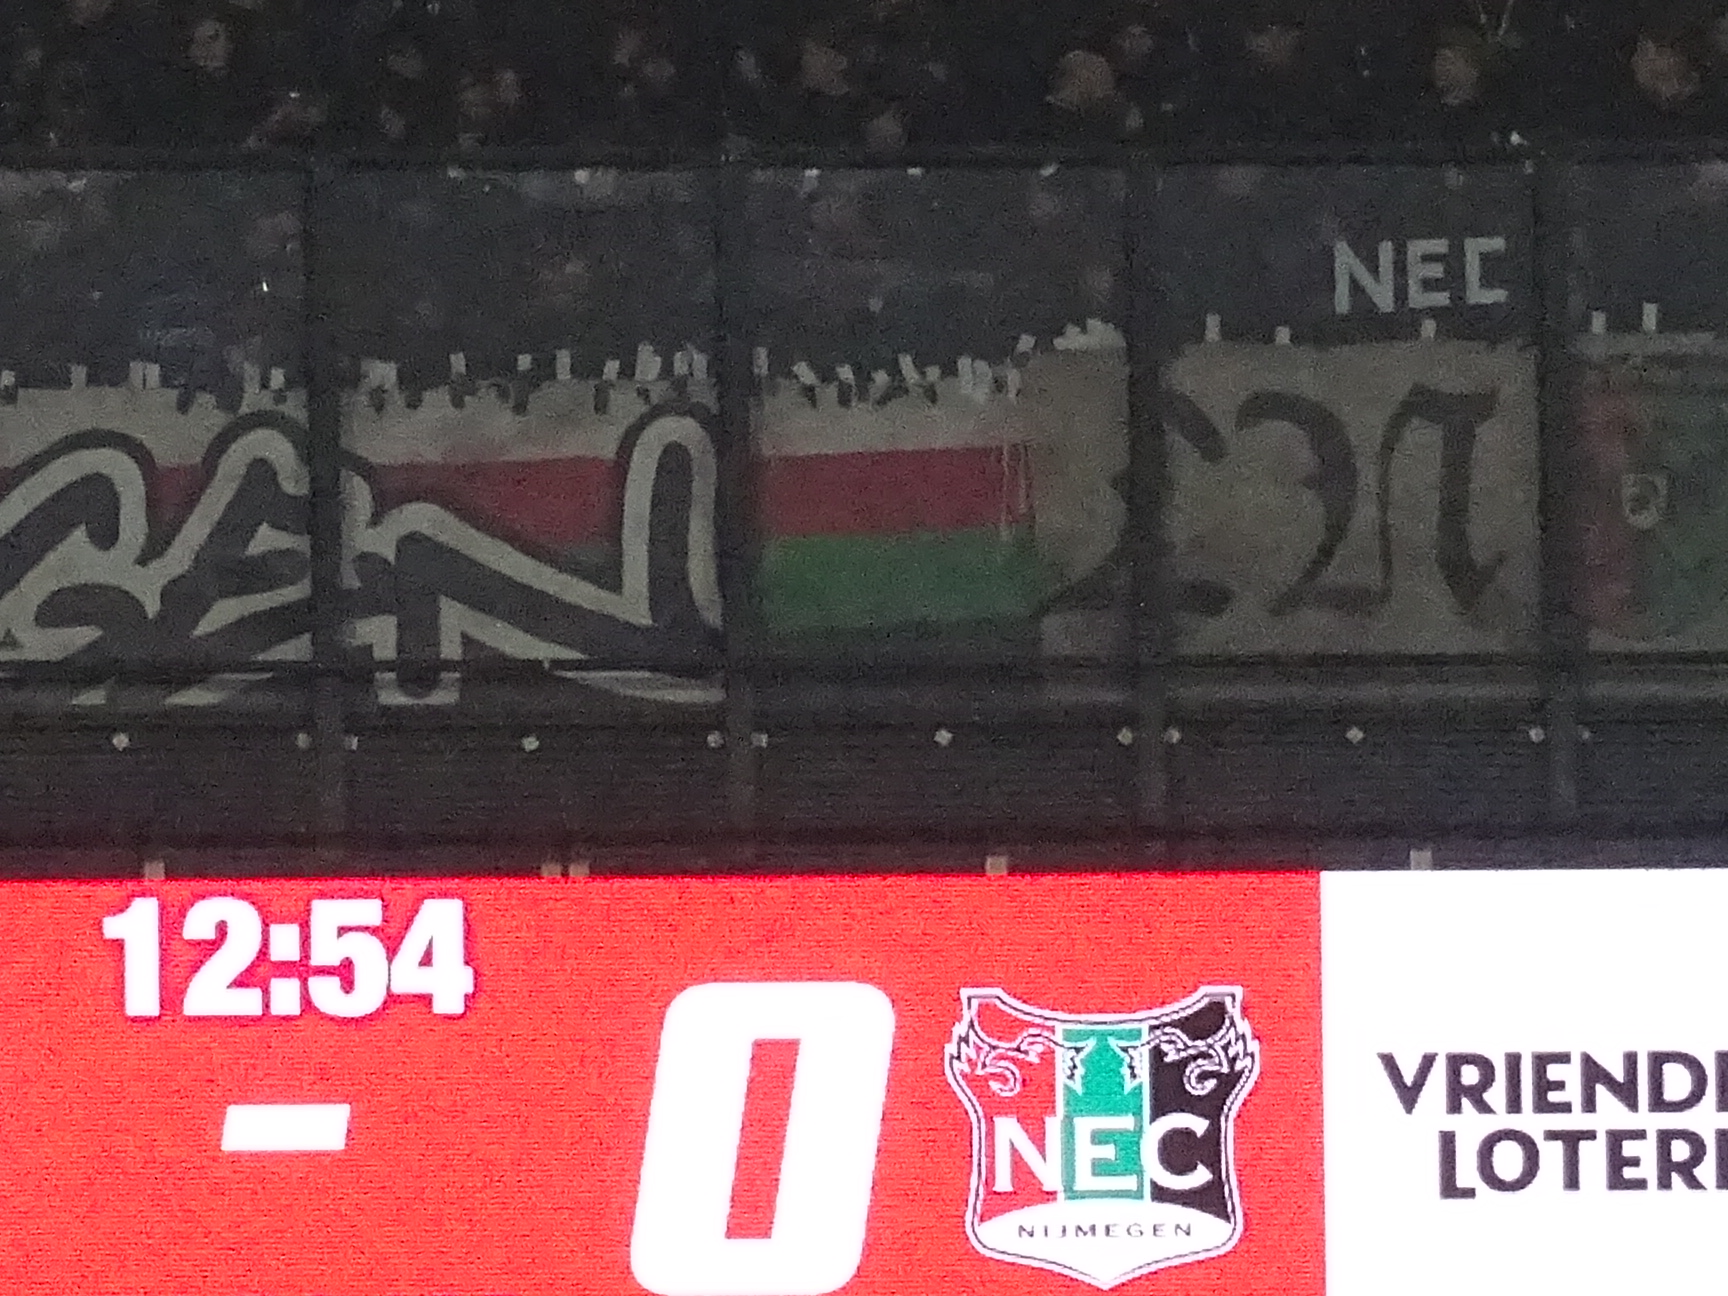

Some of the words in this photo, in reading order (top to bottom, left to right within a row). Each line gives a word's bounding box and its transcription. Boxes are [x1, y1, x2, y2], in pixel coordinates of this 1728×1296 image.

[1332, 236, 1508, 314] NEC
[102, 897, 475, 1018] 12:54
[630, 980, 896, 1296] 0
[992, 1112, 1213, 1193] NEC
[1017, 1223, 1192, 1239] NIJMEGEN
